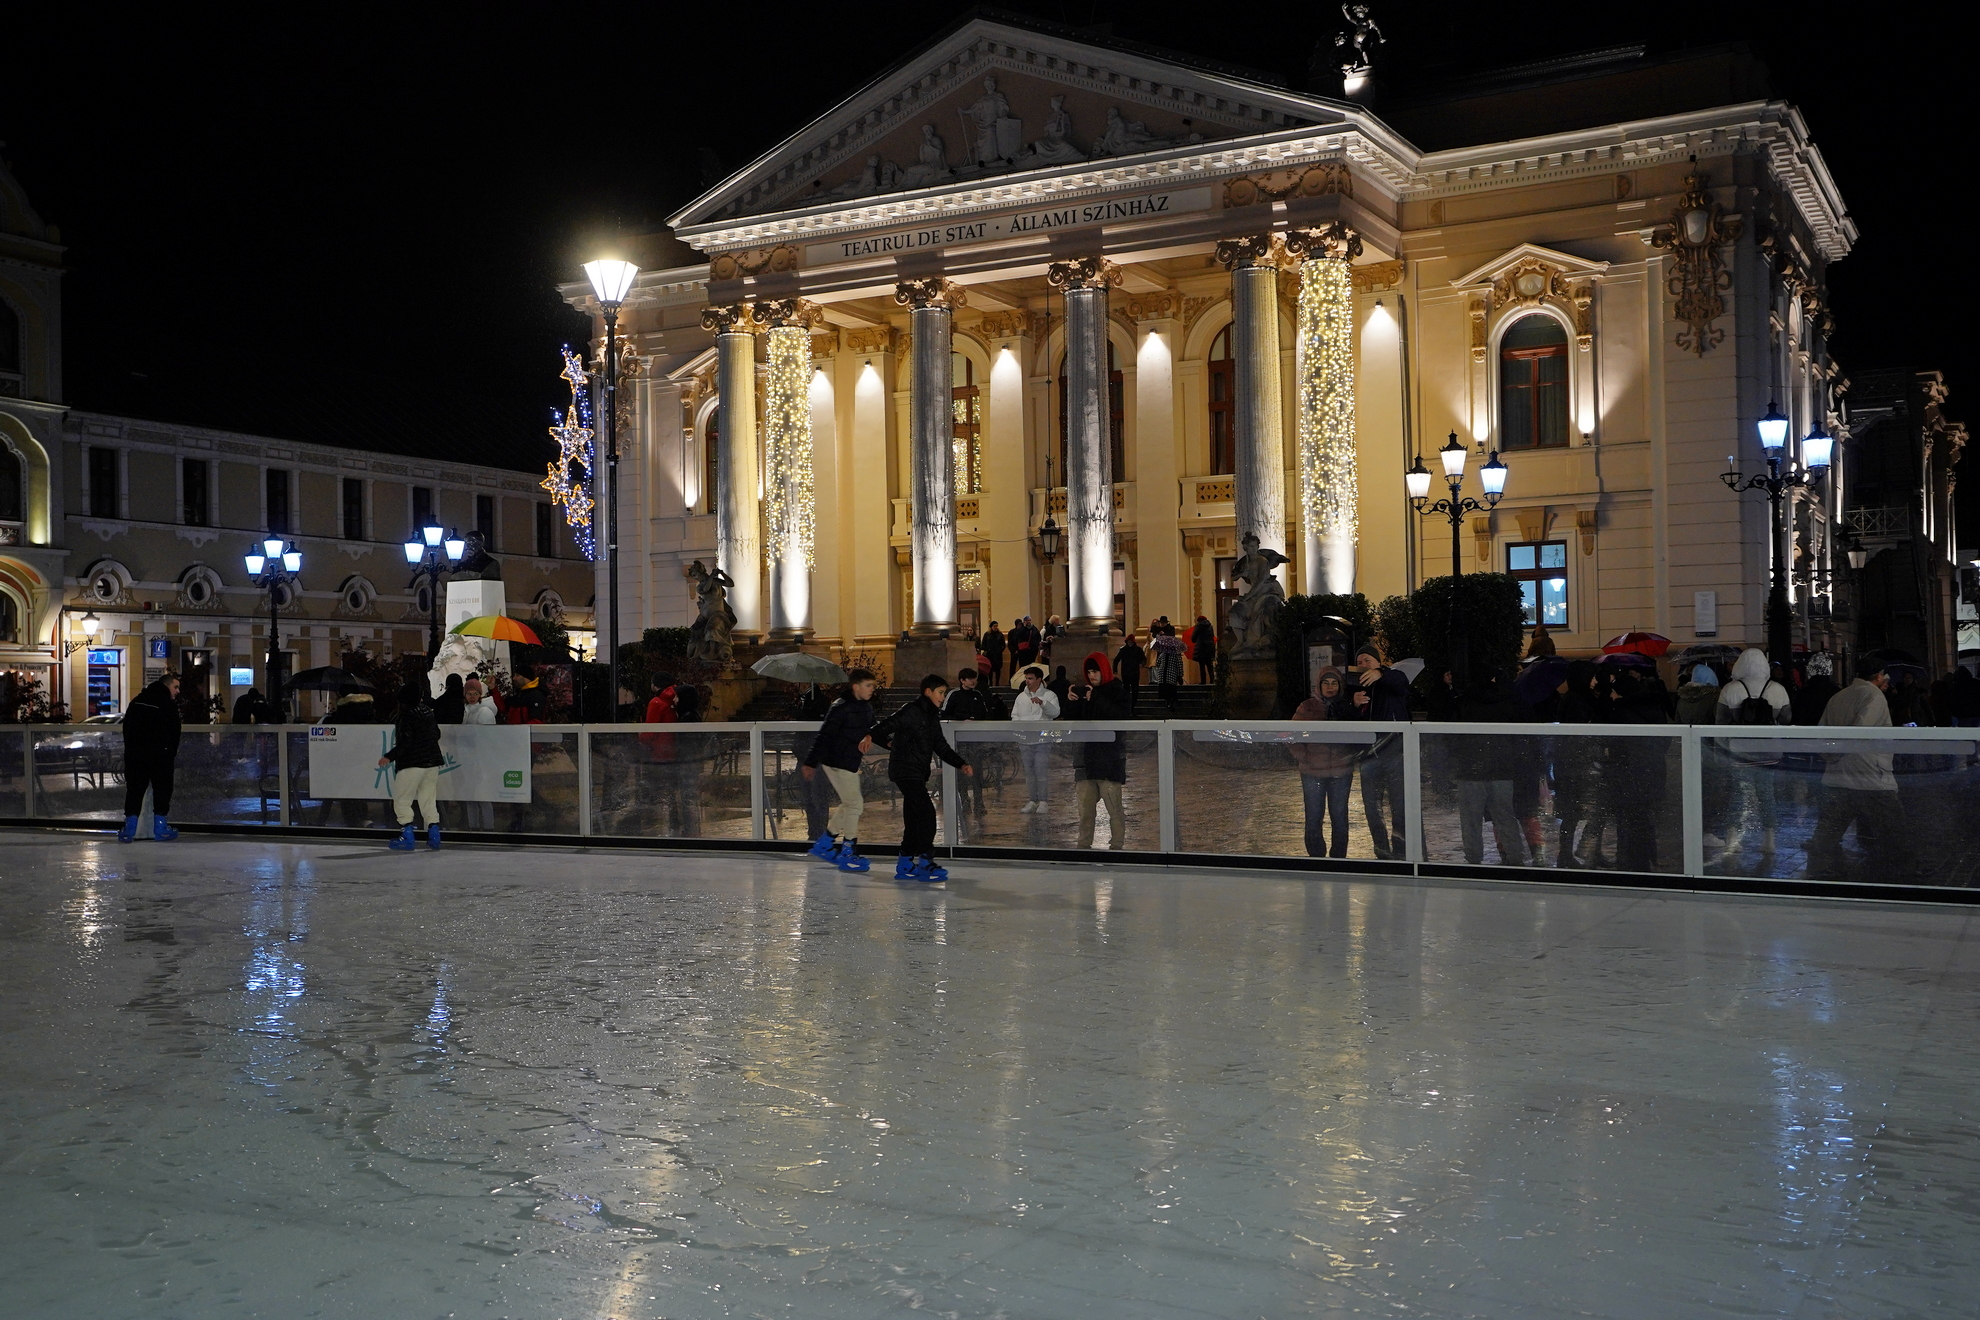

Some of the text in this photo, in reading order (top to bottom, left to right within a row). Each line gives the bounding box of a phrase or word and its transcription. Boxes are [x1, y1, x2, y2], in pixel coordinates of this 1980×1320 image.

[1010, 195, 1169, 233] ÁLLAMI SZÍNHÁZ
[842, 223, 986, 257] TEATRUL DE STAT
